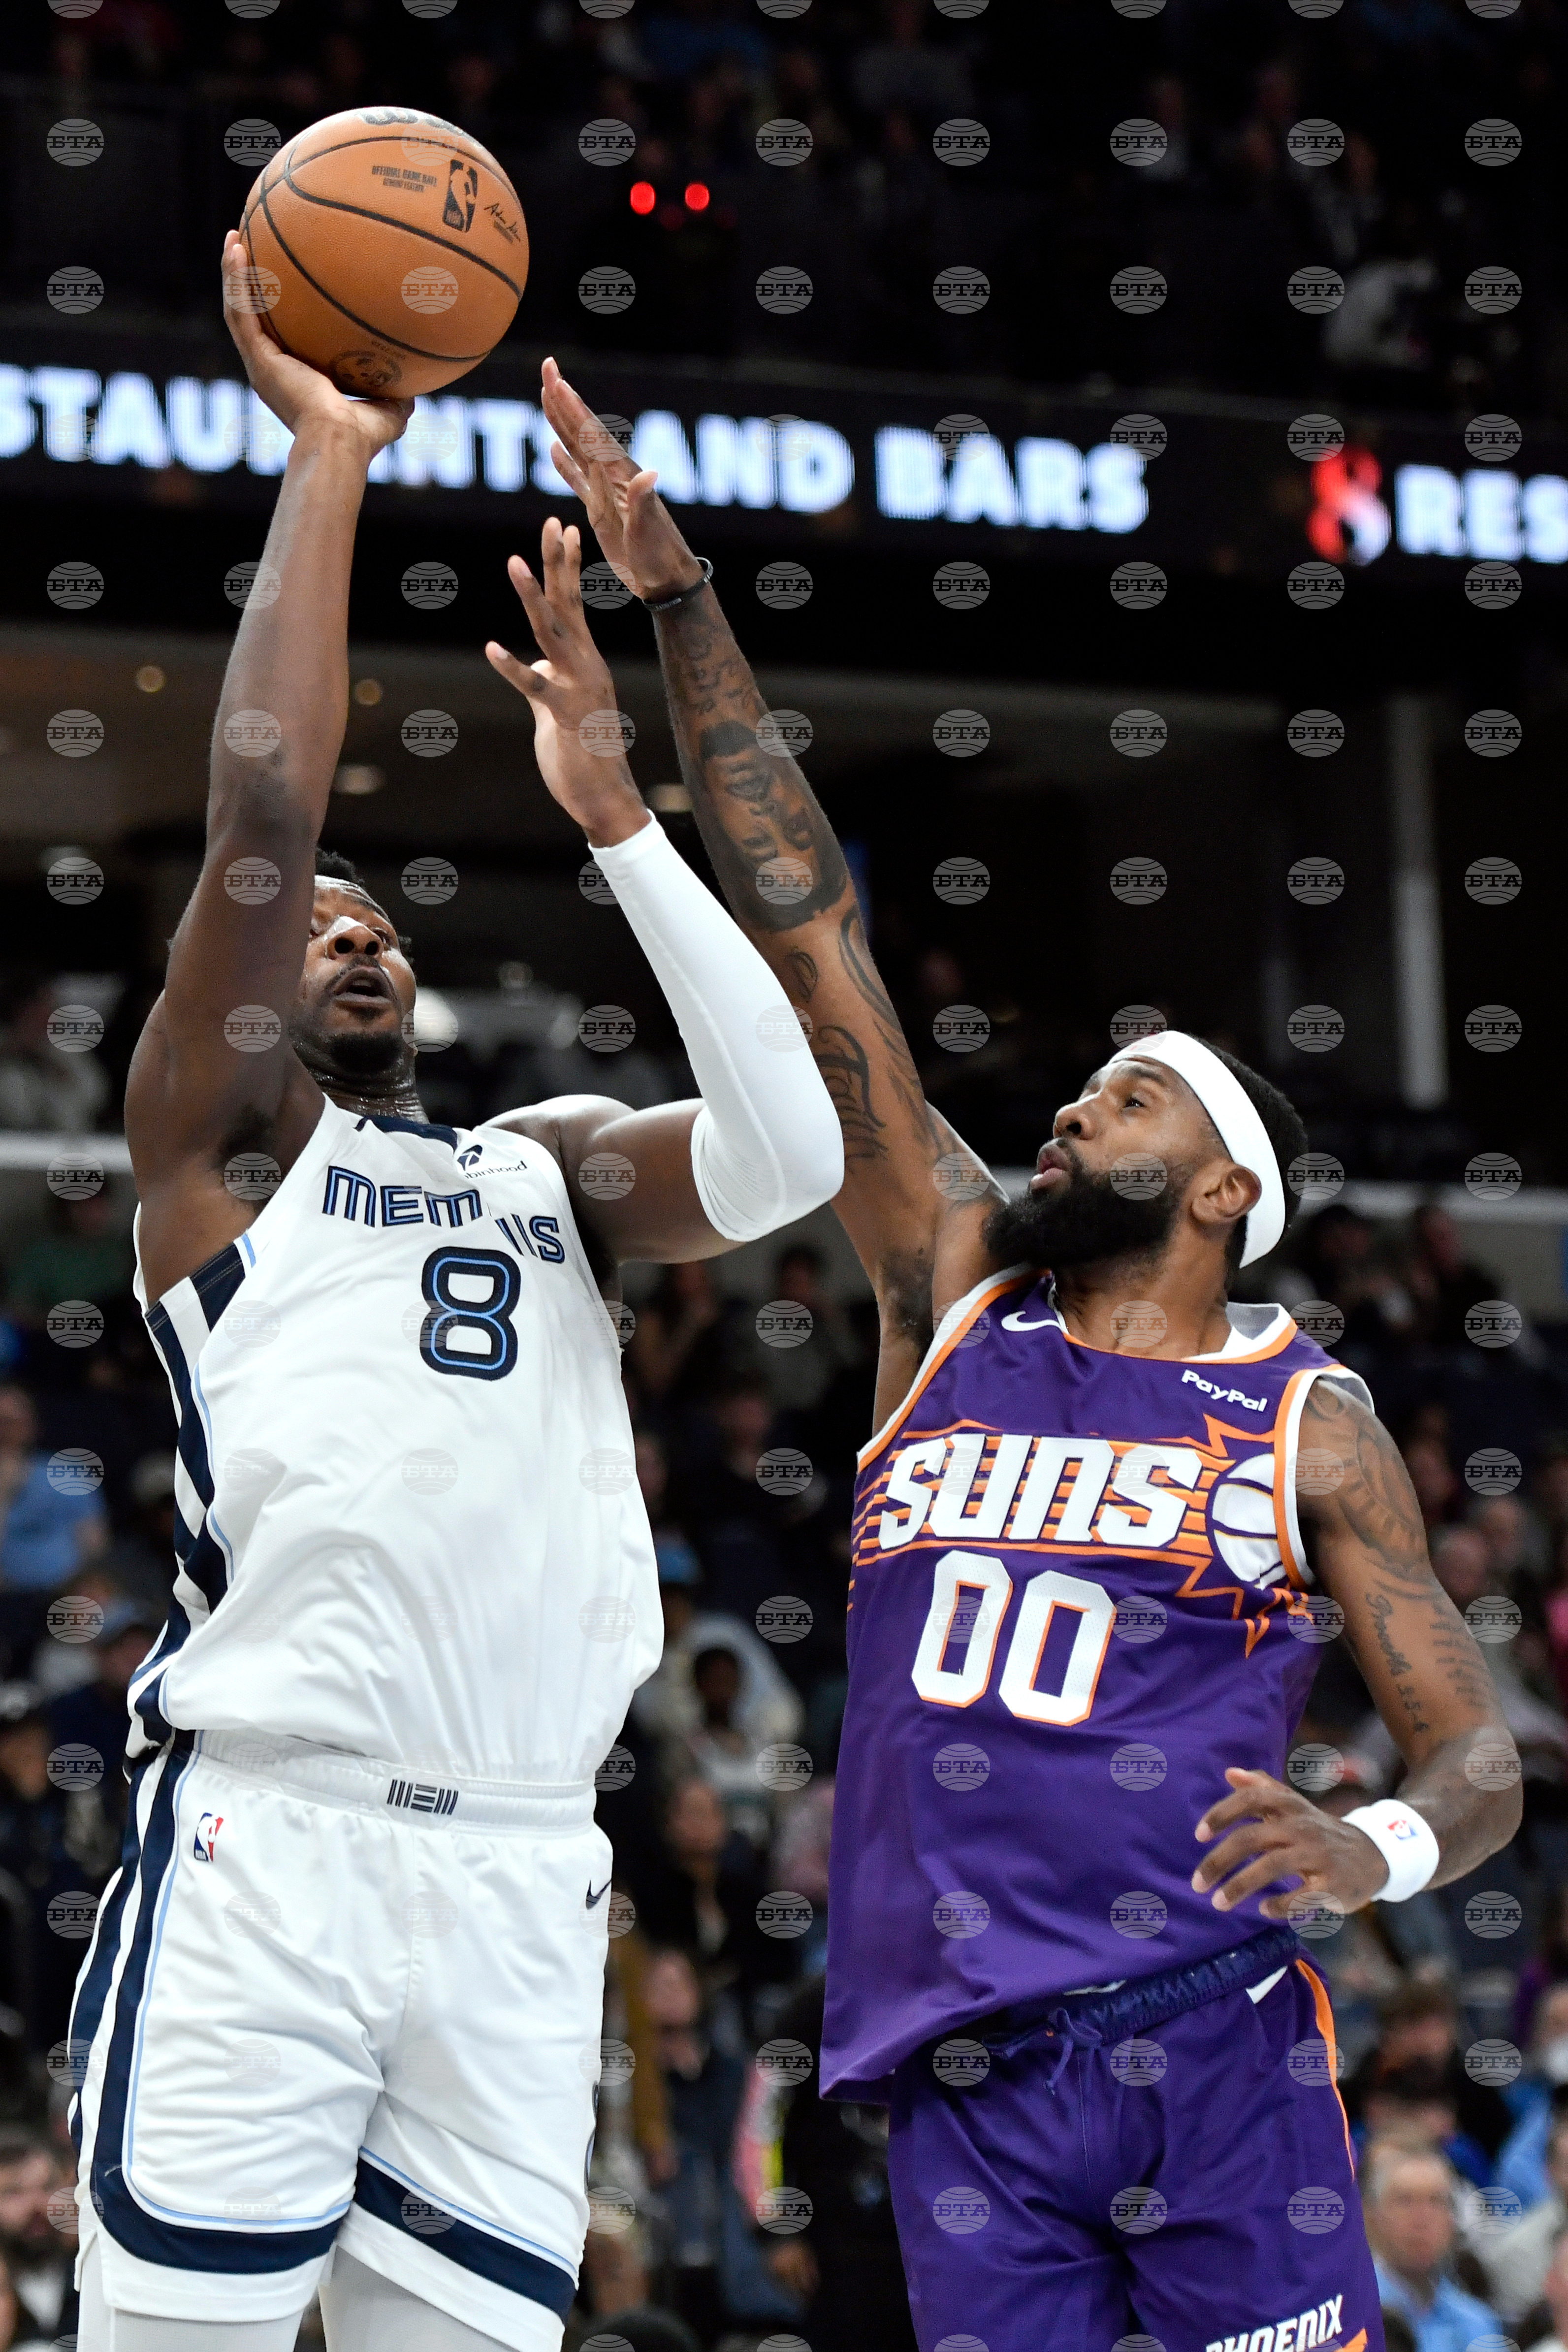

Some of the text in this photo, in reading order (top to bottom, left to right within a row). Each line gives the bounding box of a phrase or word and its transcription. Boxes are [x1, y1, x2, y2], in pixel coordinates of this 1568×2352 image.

[632, 409, 855, 515] AND
[873, 424, 1149, 534] BARS
[420, 1246, 521, 1381] 8
[1182, 1369, 1268, 1412] PayPal
[878, 1433, 1202, 1549] SUNS
[911, 1550, 1117, 1726] 00
